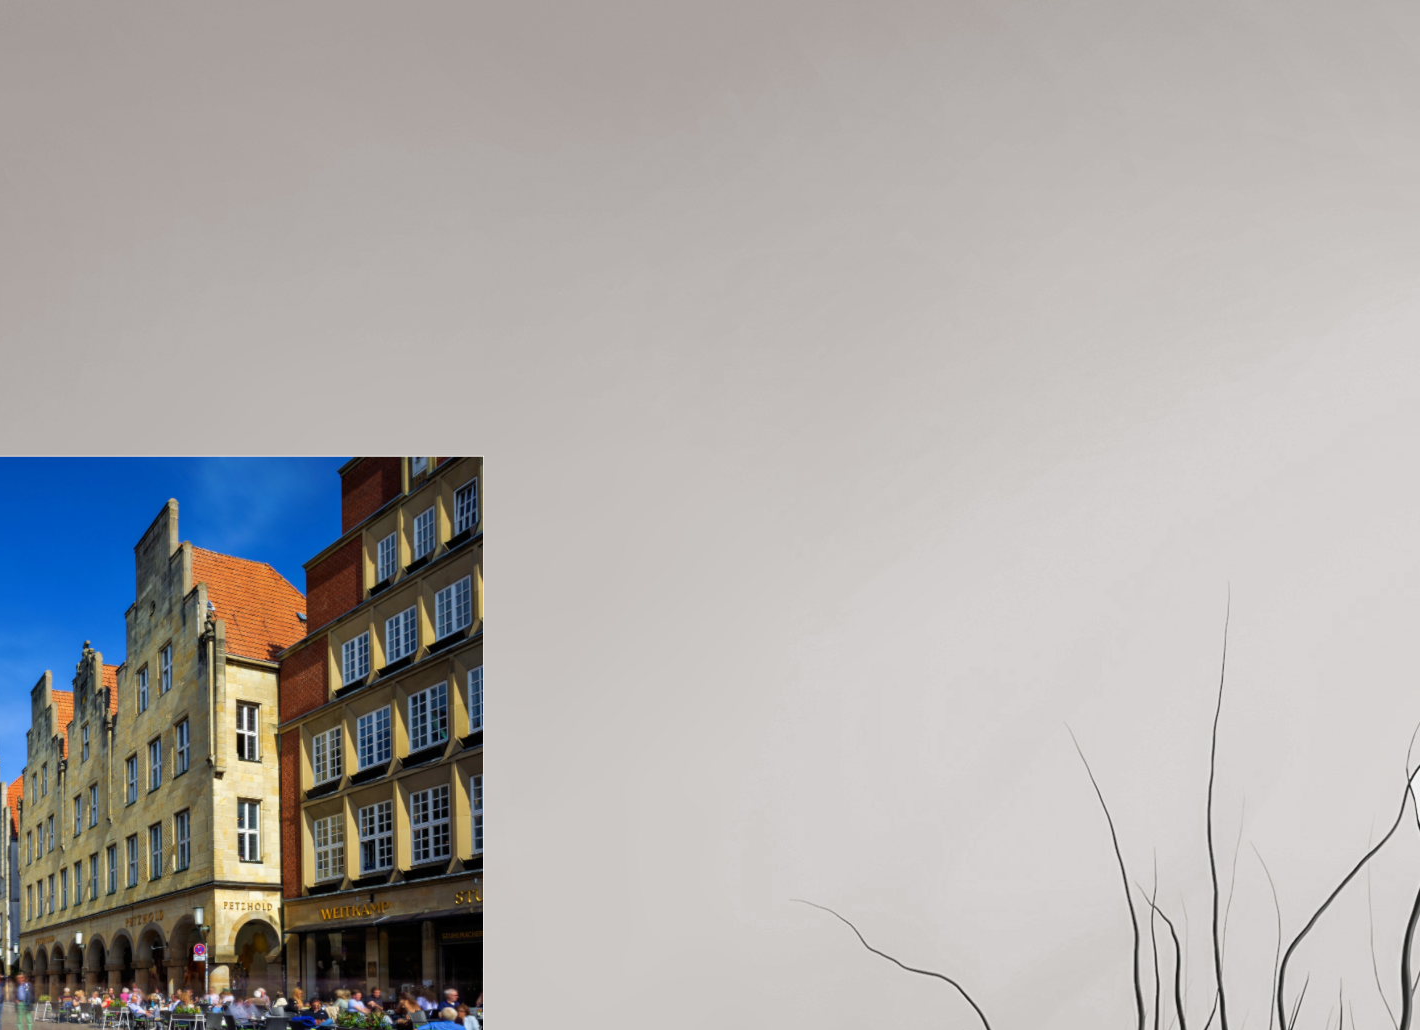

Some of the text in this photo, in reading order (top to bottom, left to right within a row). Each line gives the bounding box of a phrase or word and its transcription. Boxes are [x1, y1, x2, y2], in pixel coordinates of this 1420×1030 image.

[223, 901, 273, 911] PETZHOLD
[321, 901, 390, 920] WEITKAMP
[125, 910, 164, 927] PETZHOLD
